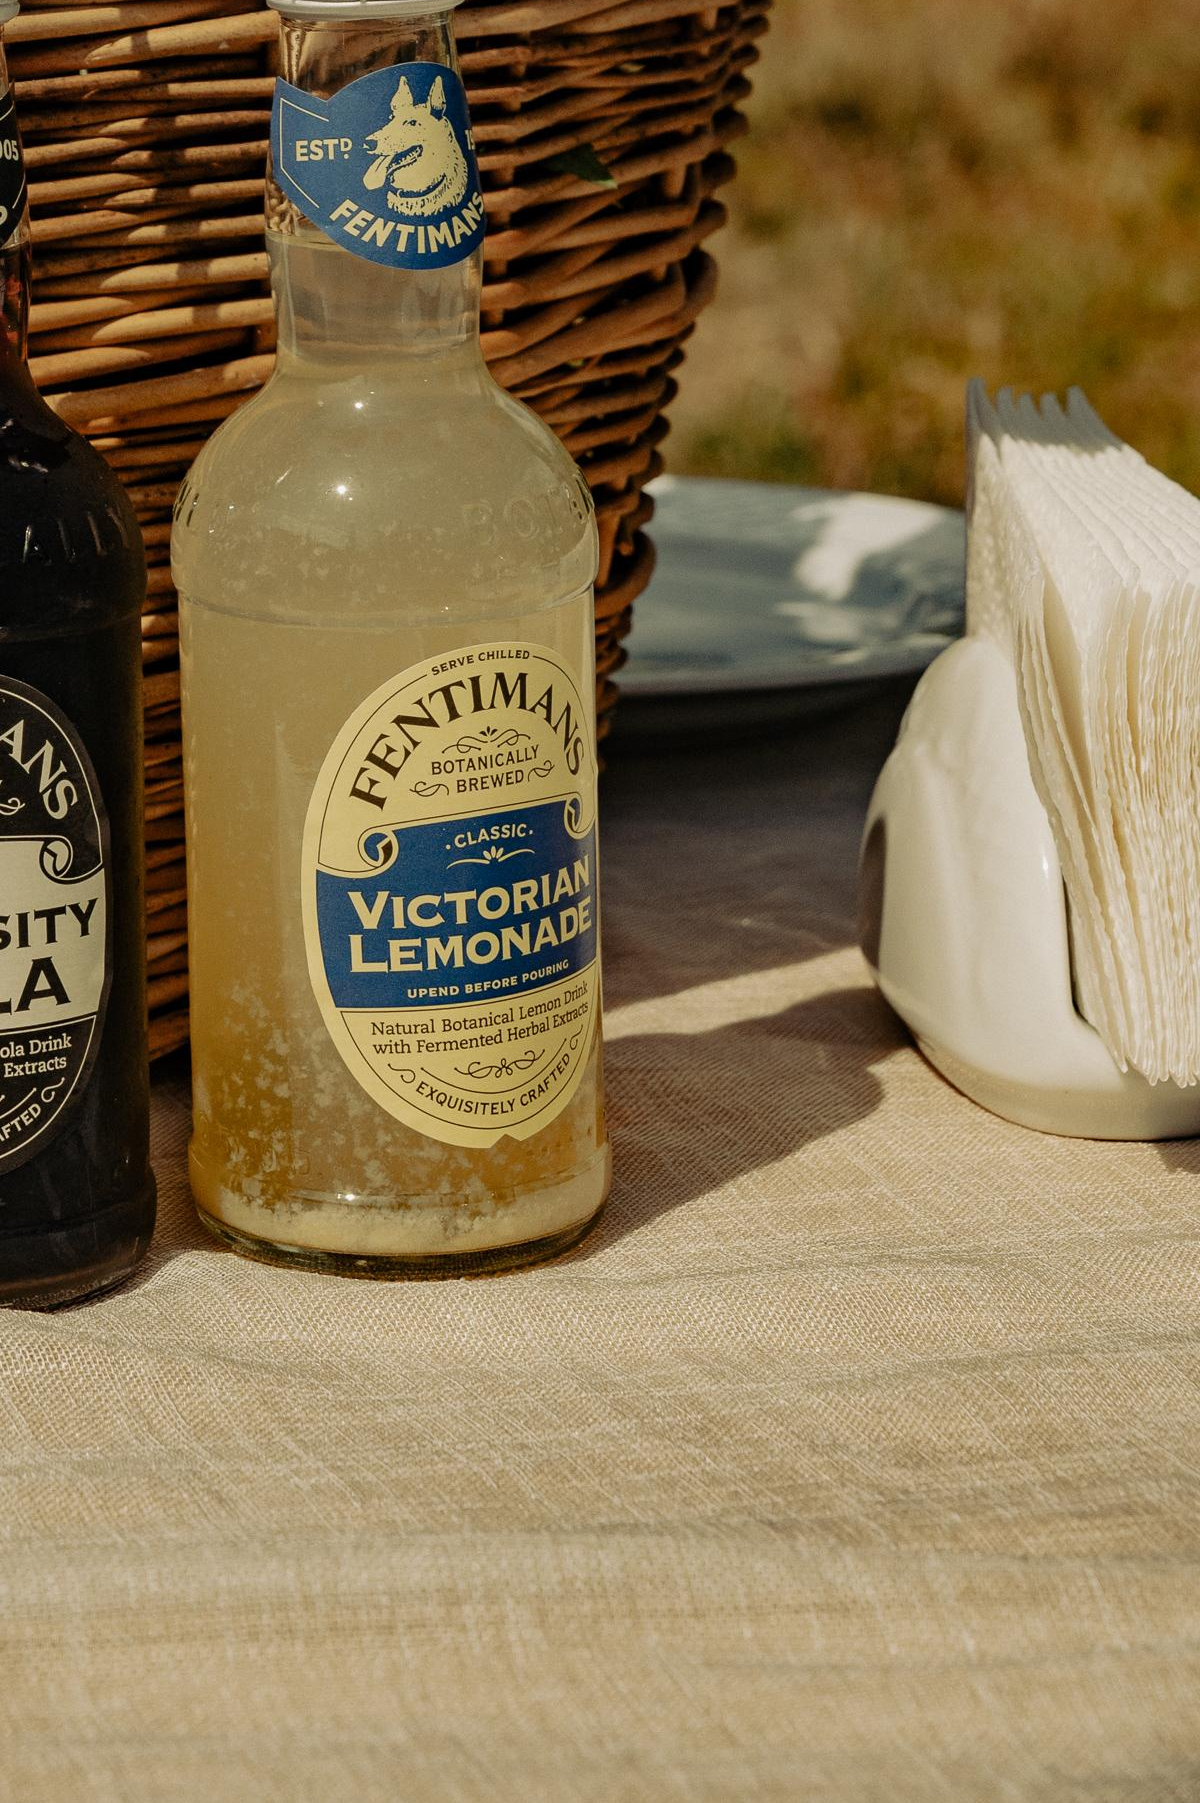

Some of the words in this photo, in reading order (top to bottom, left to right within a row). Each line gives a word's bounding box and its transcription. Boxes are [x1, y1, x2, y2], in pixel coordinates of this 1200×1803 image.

[329, 192, 485, 254] FENTIMANS
[431, 654, 475, 677] SERVE
[477, 649, 531, 664] CHILLED
[348, 671, 585, 811] FENTIMANS
[430, 743, 540, 776] BOTANICALLY
[456, 769, 526, 794] BREWED
[346, 853, 592, 931] VICTORIAN
[348, 895, 593, 973] LEMONADE
[407, 982, 461, 1000] UPEND
[464, 975, 520, 995] BEFORE
[522, 958, 571, 987] POURING
[371, 1018, 437, 1039] Natural
[441, 1008, 517, 1035] Botanical
[519, 996, 562, 1023] Lemon
[563, 981, 590, 1008] Drink
[373, 1038, 413, 1056] with
[416, 1028, 504, 1055] Fermented
[506, 1019, 551, 1048] Herbal
[552, 1001, 590, 1036] Extracts
[3, 1054, 67, 1079] Extracts
[29, 1033, 73, 1057] Drink
[415, 1079, 517, 1117] EXQUISITELY
[519, 1053, 573, 1107] CRAFTED
